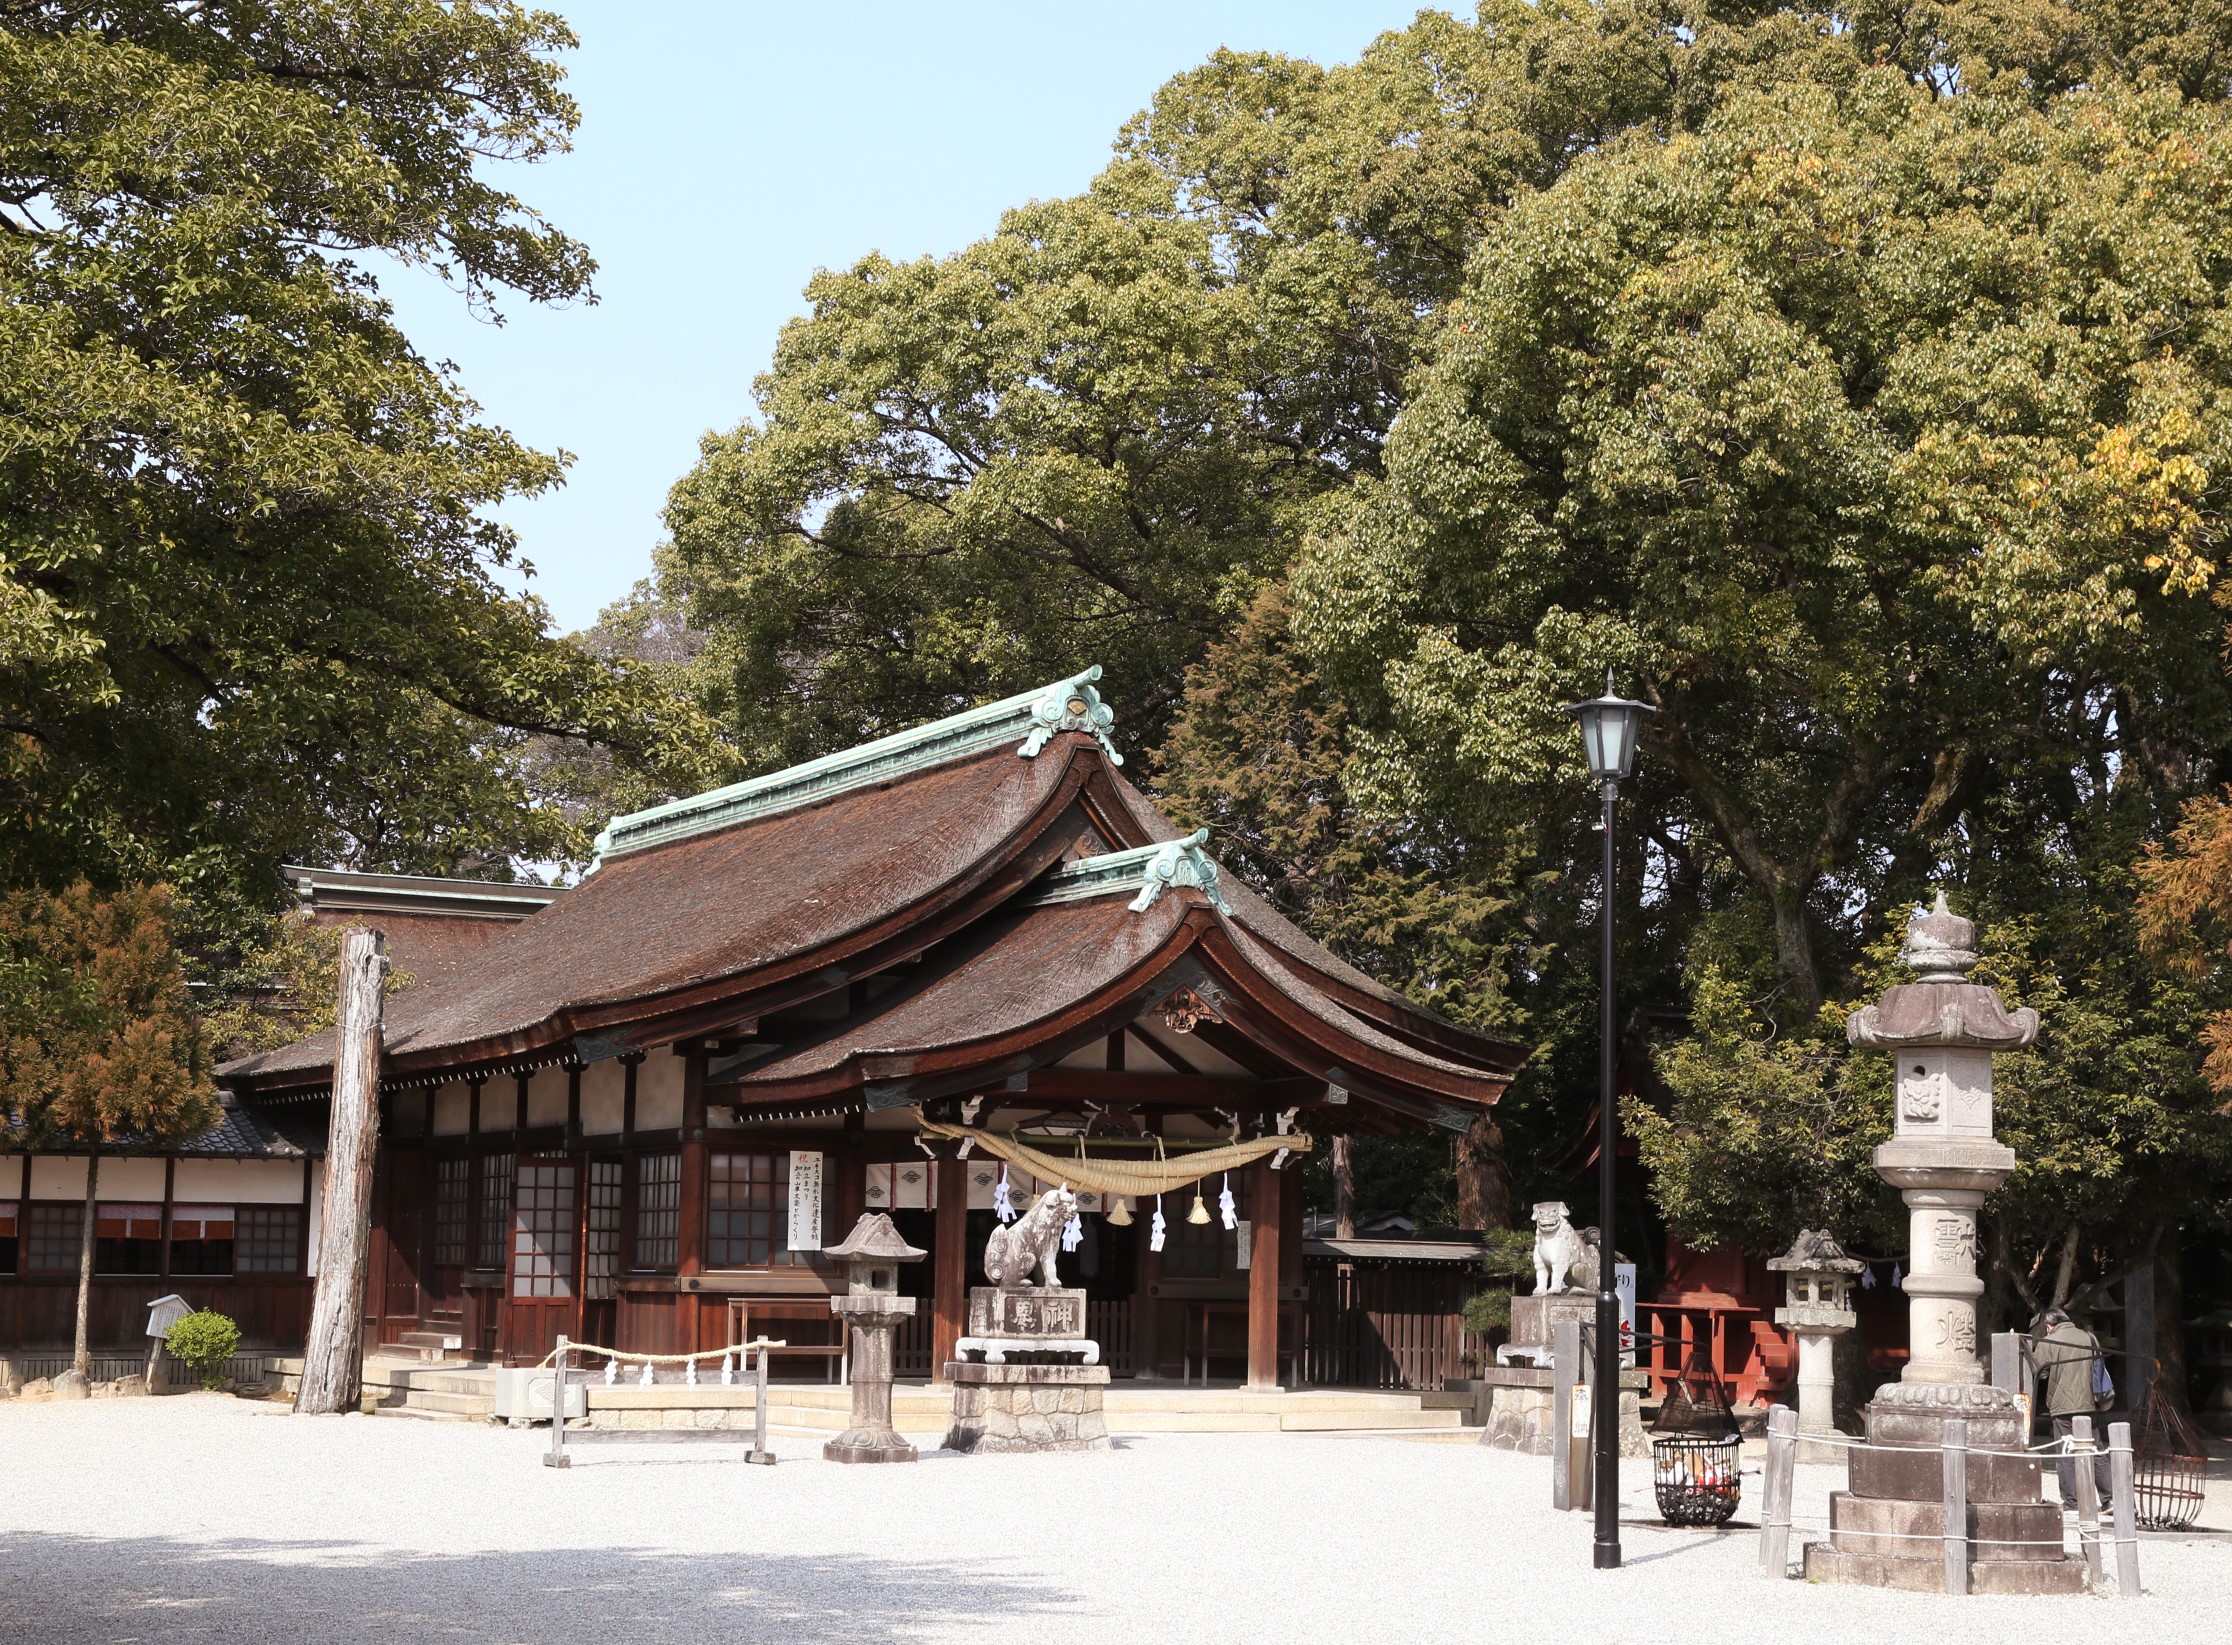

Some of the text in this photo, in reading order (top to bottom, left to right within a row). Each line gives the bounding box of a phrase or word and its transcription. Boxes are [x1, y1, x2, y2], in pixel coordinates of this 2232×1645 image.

[798, 1154, 809, 1163] 祝
[803, 1165, 811, 1201] 知立まつり
[810, 1157, 821, 1241] ユネスコ無形文化遺産登録
